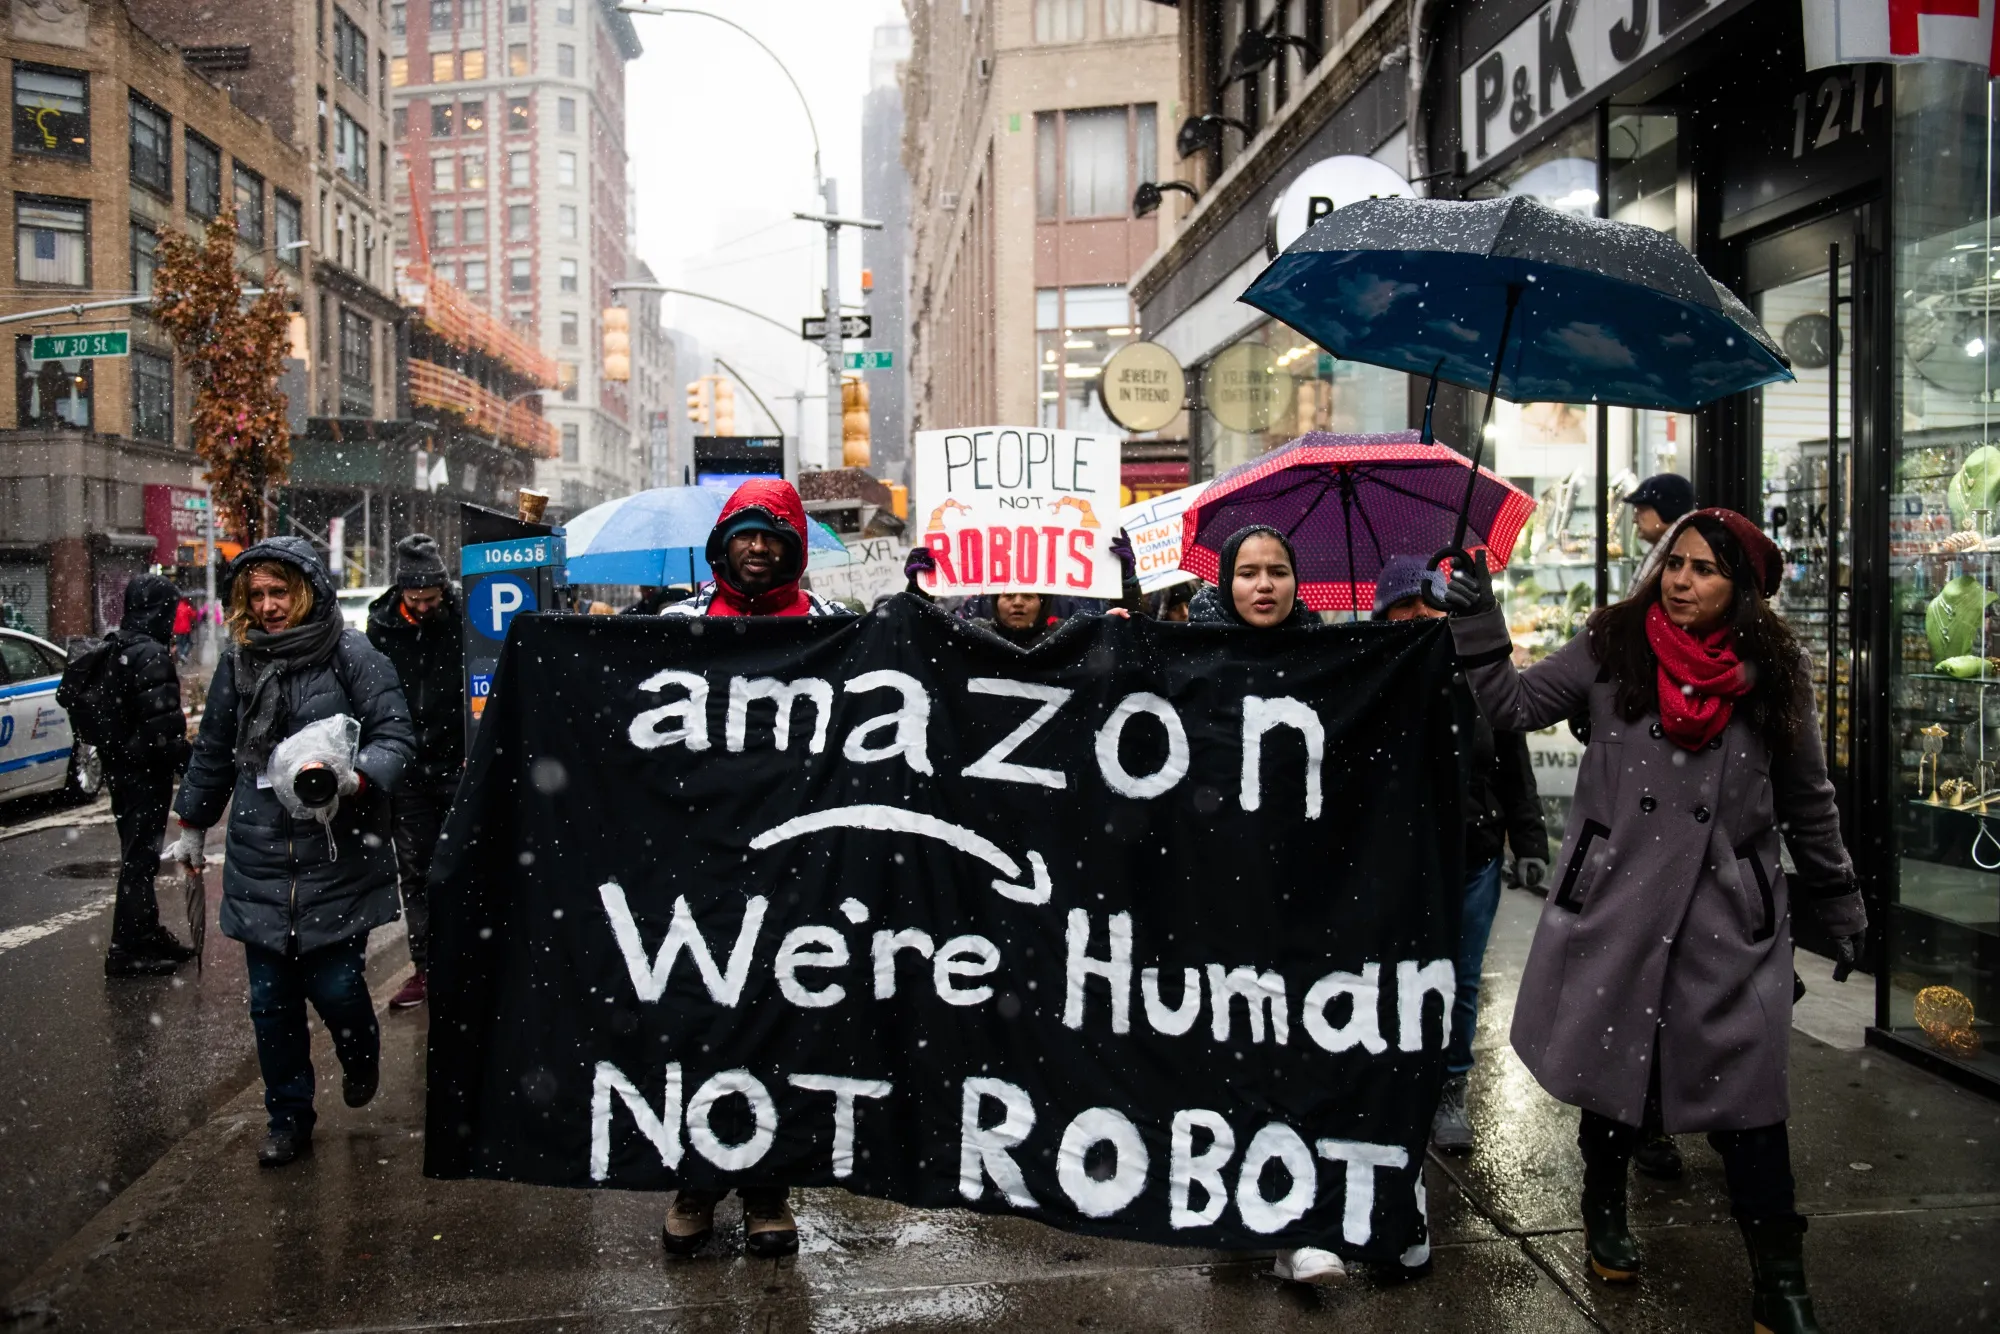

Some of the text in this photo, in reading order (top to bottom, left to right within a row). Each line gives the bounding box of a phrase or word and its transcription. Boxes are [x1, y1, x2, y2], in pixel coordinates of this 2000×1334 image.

[54, 337, 108, 356] W 30 St
[861, 352, 877, 368] 30
[1118, 368, 1168, 384] JEWELRY
[1120, 387, 1169, 403] IN TREND
[945, 430, 1096, 493] PEOPLE
[999, 496, 1043, 509] NOT
[1136, 525, 1170, 545] NEW
[485, 548, 545, 563] 106638
[923, 526, 1095, 590] ROBOTS
[1140, 547, 1180, 572] CHA
[865, 566, 892, 577] WITH
[491, 583, 523, 631] P
[628, 668, 1325, 820] amazon
[599, 881, 1457, 1054] We're Human
[590, 1060, 894, 1181] NOT
